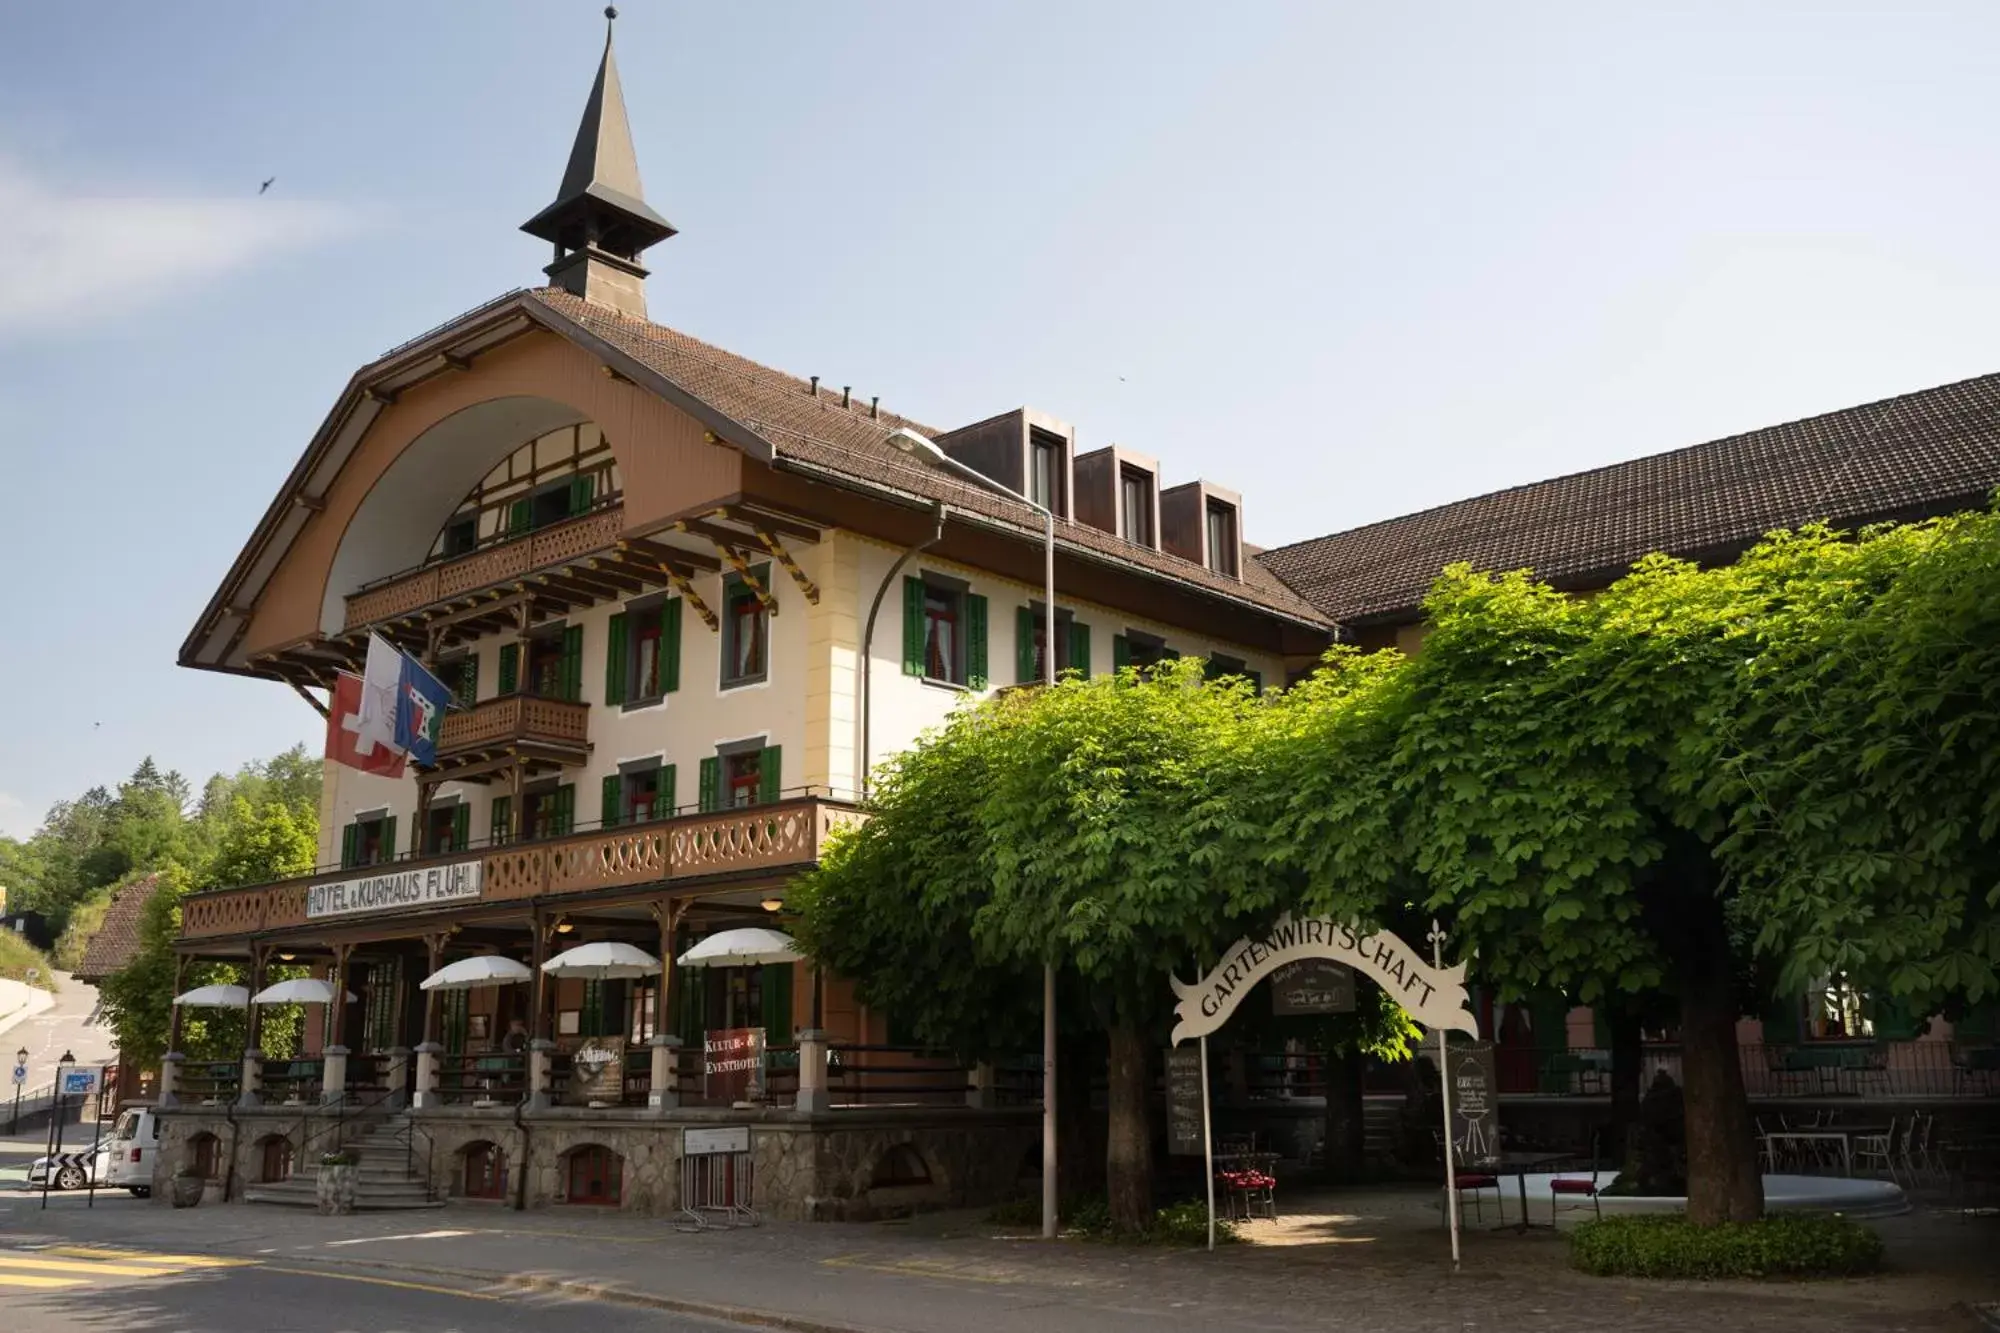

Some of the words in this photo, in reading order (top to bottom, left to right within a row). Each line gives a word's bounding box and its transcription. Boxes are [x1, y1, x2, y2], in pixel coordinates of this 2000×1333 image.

[309, 885, 348, 914] HOTEL
[358, 873, 420, 907] KURHAUS
[1201, 920, 1436, 1017] GARTENWIRTSCHAFT
[706, 1057, 763, 1074] EVENTHOTEL
